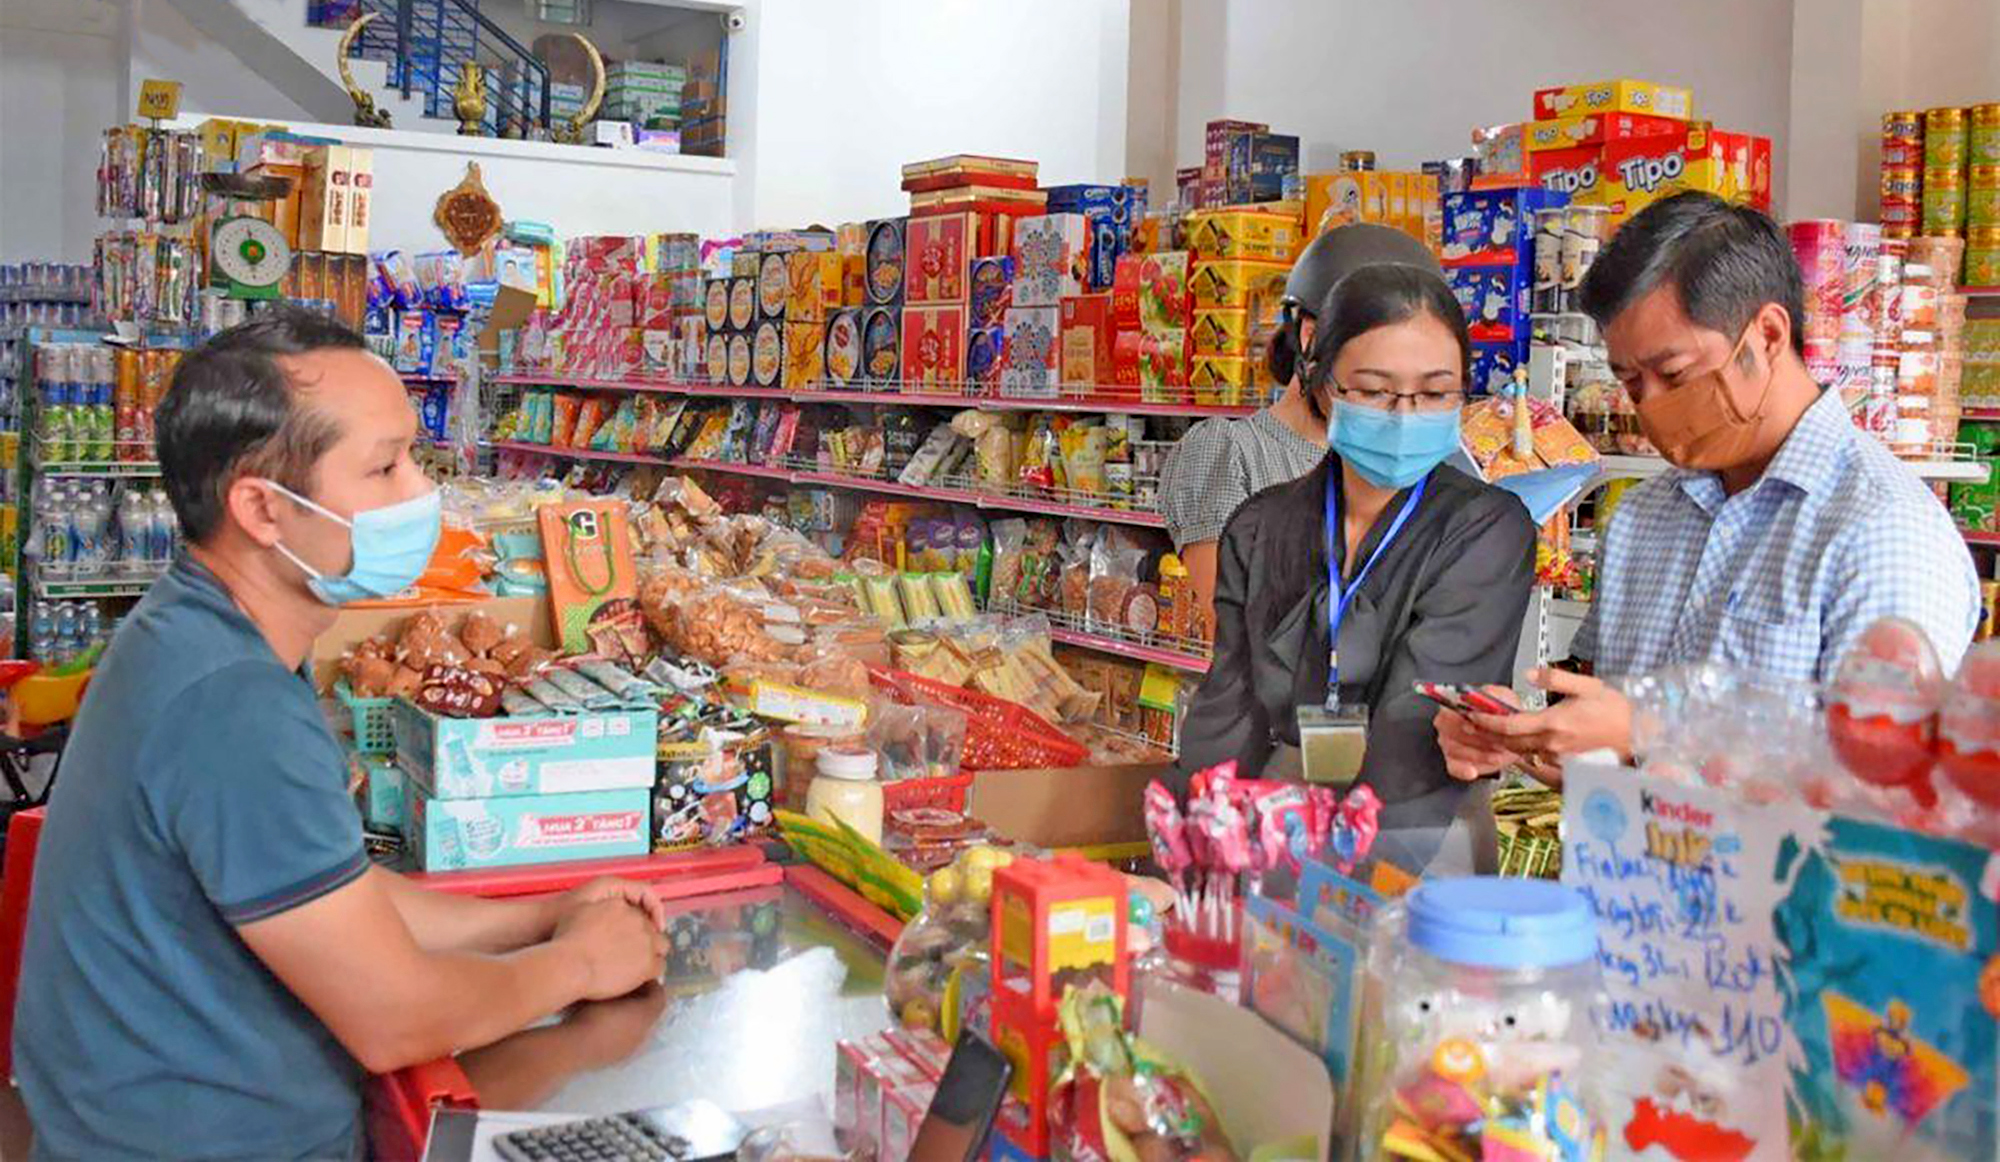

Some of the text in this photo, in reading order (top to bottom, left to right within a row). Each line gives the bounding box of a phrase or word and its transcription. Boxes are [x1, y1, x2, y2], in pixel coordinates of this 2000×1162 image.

[1618, 153, 1684, 193] Tipo
[573, 816, 586, 832] 2
[1641, 788, 1713, 826] Kinder
